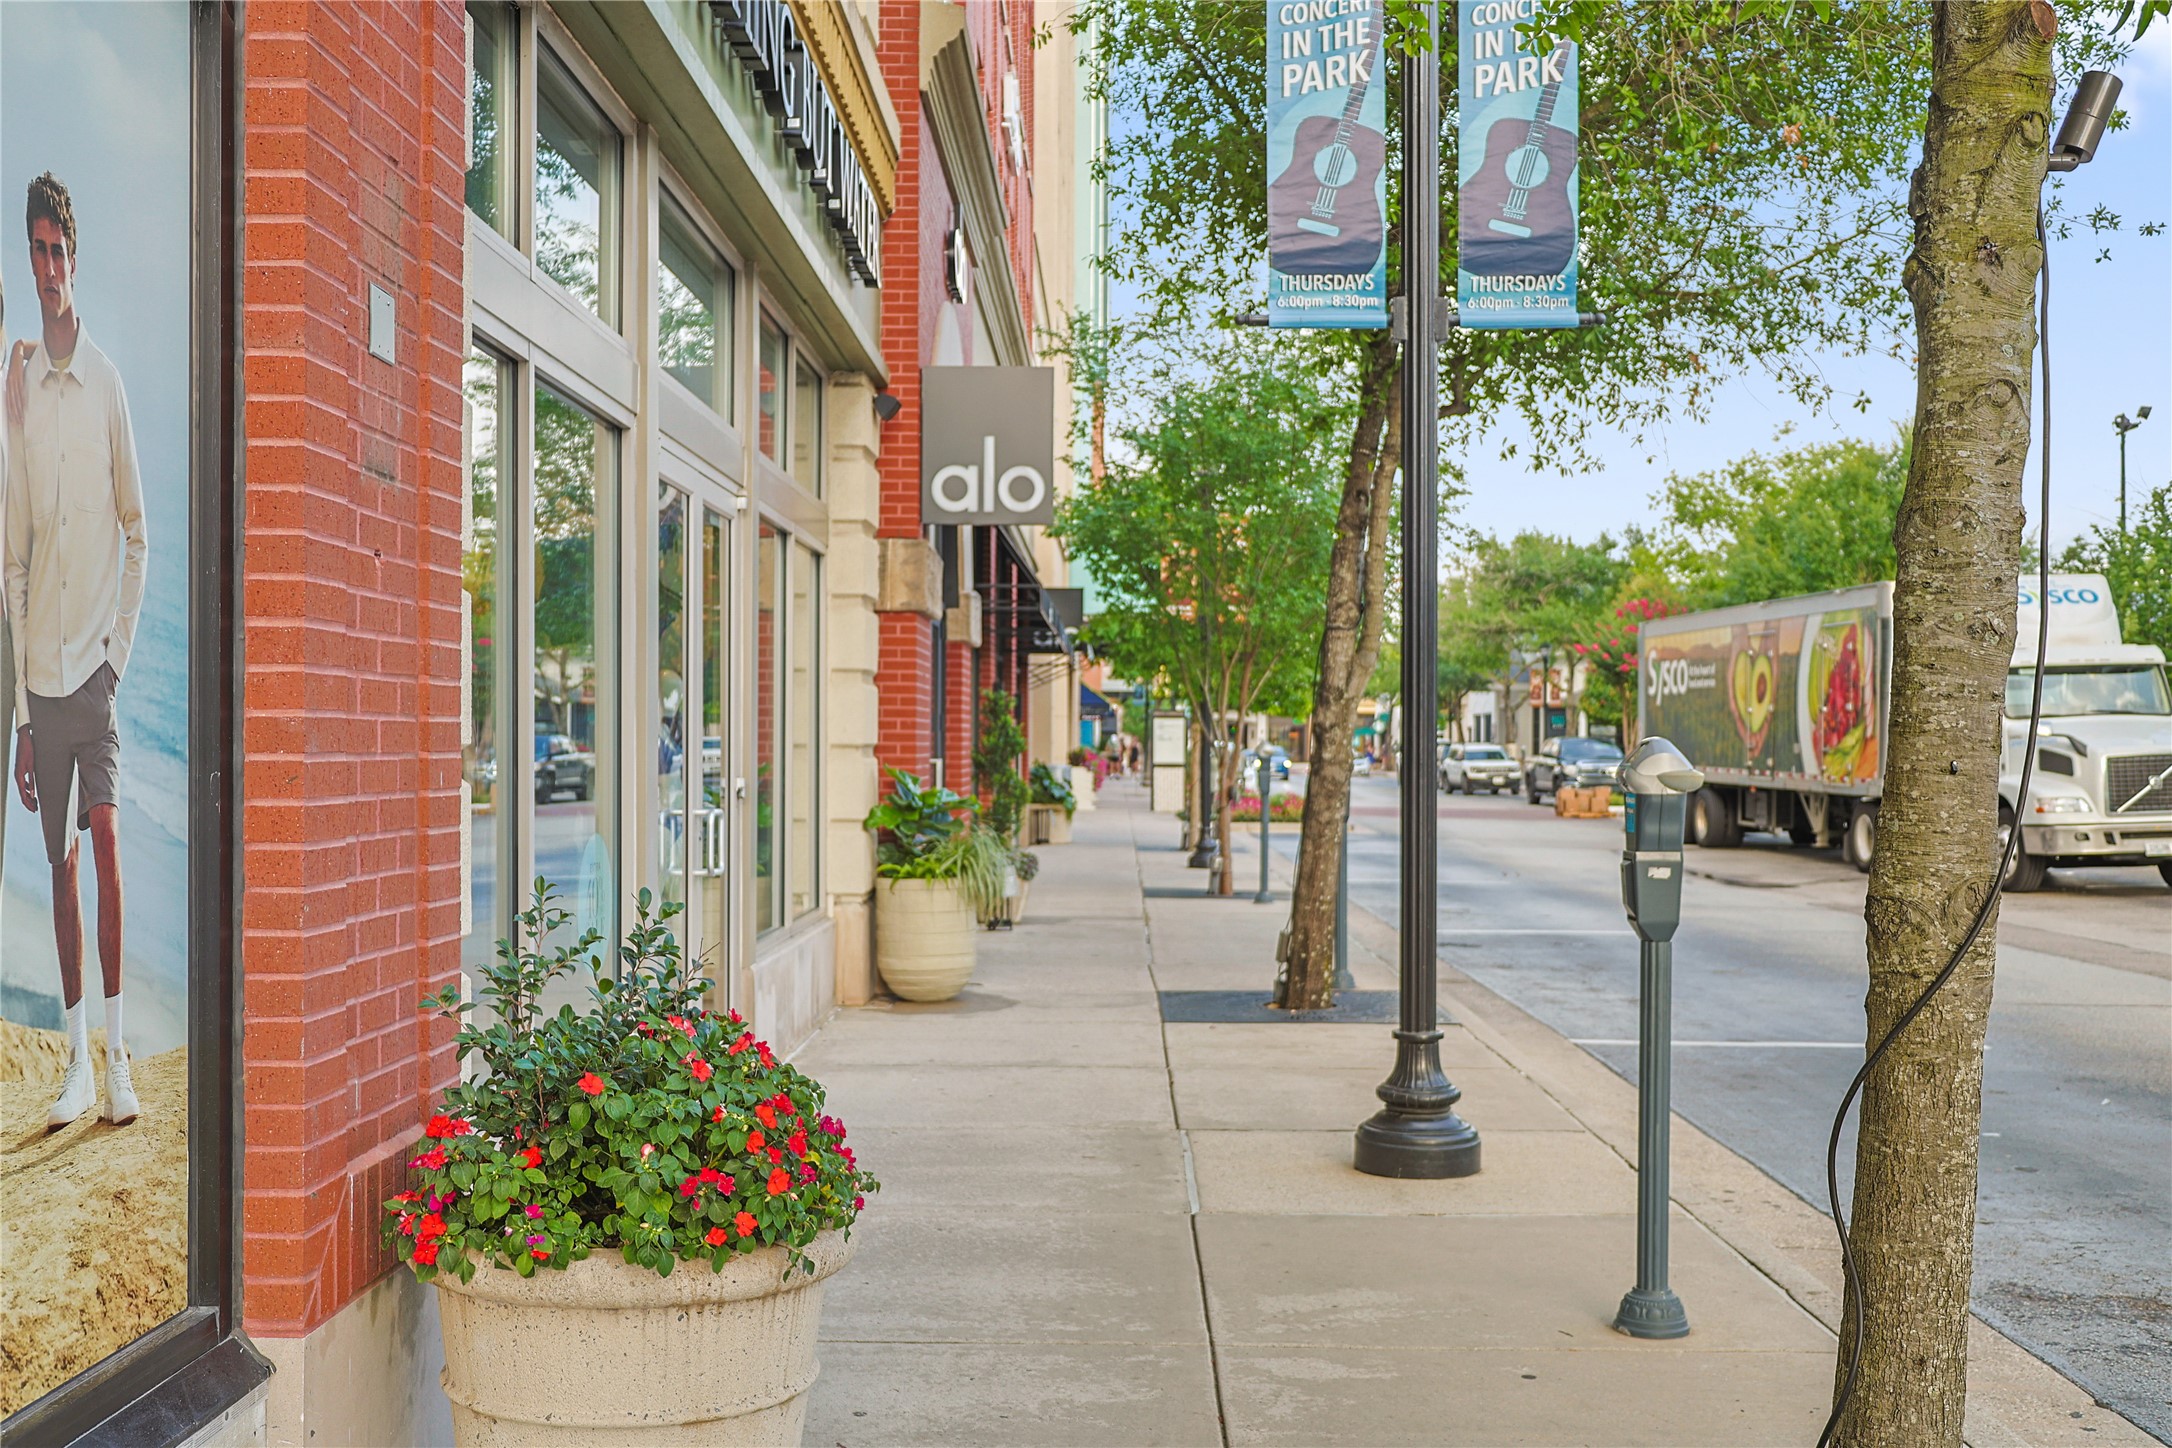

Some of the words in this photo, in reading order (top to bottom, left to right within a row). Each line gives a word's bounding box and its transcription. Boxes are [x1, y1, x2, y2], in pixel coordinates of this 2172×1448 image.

[1283, 29, 1311, 59] IN
[1318, 17, 1371, 52] THE
[1475, 29, 1503, 59] IN
[1283, 49, 1371, 97] PARK
[1475, 49, 1564, 98] PARK
[802, 40, 837, 194] BUT
[838, 121, 883, 290] WATER
[1280, 273, 1375, 292] THURSDAYS
[1470, 274, 1567, 293] THURSDAYS
[1277, 295, 1321, 310] 6:00pm
[1332, 295, 1378, 310] 8:30pm
[1467, 296, 1512, 311] 6:00pm
[1523, 294, 1569, 309] 8:30pm
[931, 435, 1046, 513] alo
